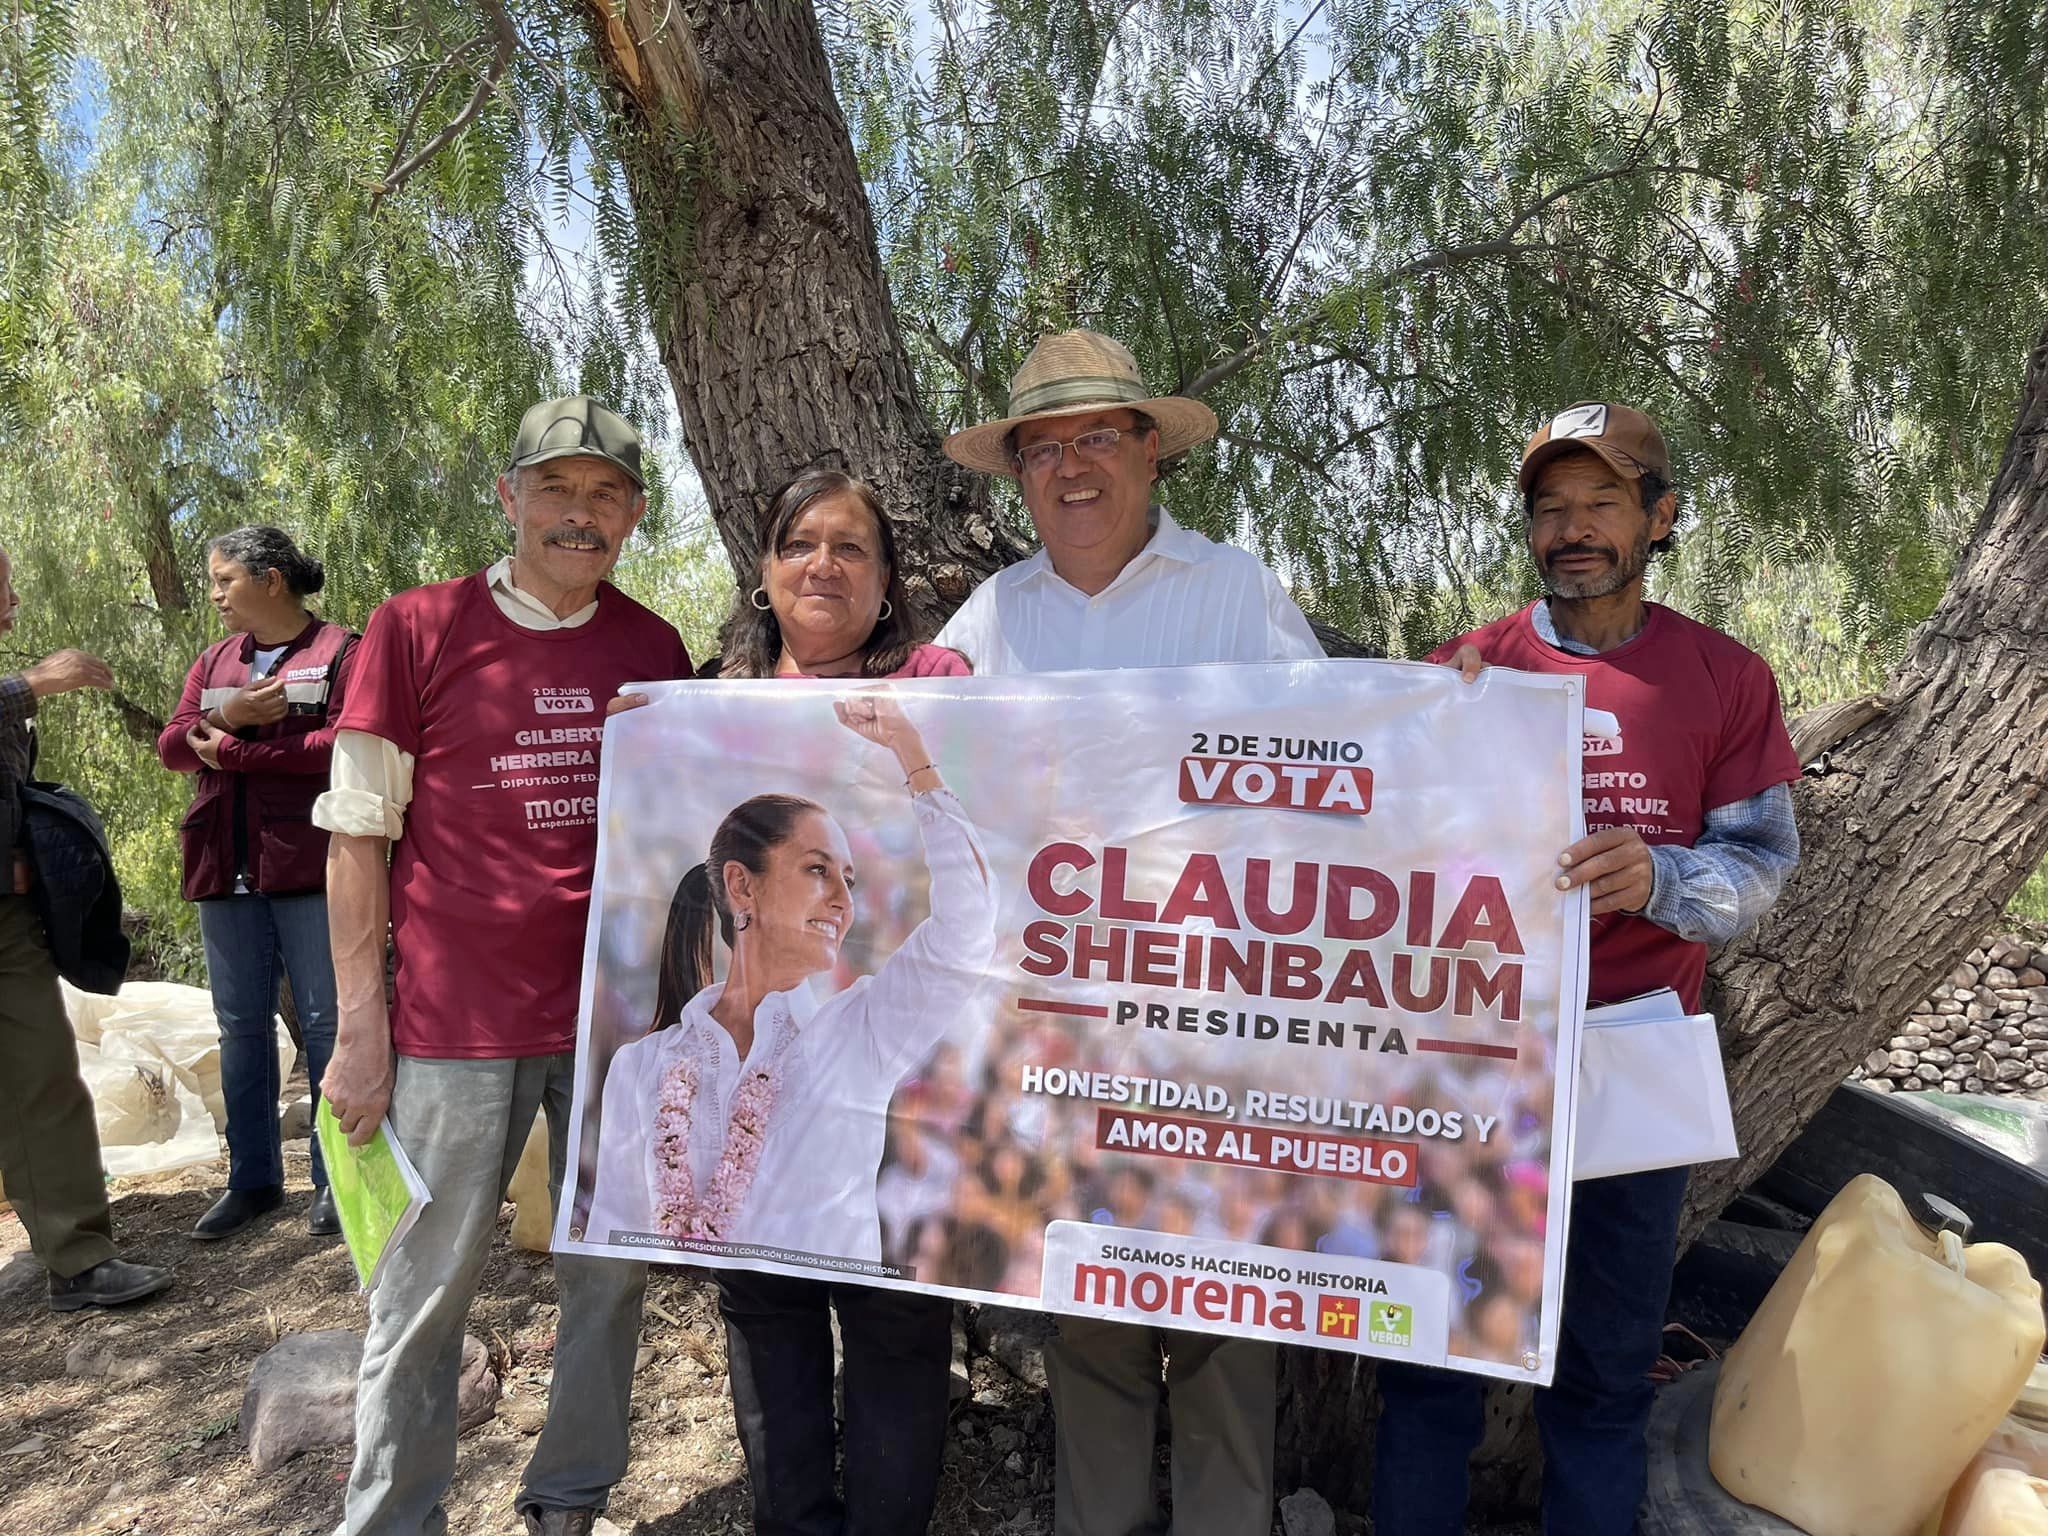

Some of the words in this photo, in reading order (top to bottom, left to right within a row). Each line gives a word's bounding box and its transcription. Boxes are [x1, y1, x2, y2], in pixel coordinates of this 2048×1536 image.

[533, 688, 540, 697] 2
[542, 688, 557, 696] DE
[559, 687, 590, 696] JUNIO
[544, 699, 586, 710] VOTA
[515, 727, 603, 746] GILBERT
[1191, 733, 1209, 754] 2
[1217, 734, 1259, 757] DE
[1267, 737, 1363, 763] JUNIO
[1583, 740, 1613, 751] OTA
[490, 750, 595, 772] HERRERA
[501, 775, 570, 789] DIPUTADO
[1185, 759, 1366, 810] VOTA
[1582, 772, 1647, 789] ERTO
[525, 796, 596, 820] more
[1620, 797, 1669, 816] RUIZ
[528, 822, 539, 830] La
[541, 818, 585, 830] esperanza
[1027, 841, 1526, 956] CLAUDIA
[1018, 920, 1525, 1022] SHEINBAUM
[1116, 1000, 1408, 1055] PRESIDENTA
[1021, 1064, 1236, 1120] HONESTIDAD,
[1246, 1089, 1463, 1140] RESULTADOS
[1473, 1113, 1497, 1143] Y
[1106, 1118, 1208, 1154] AMOR
[1215, 1131, 1261, 1163] AL
[1270, 1137, 1408, 1180] PUEBLO
[628, 1236, 675, 1248] CANDIDATA
[684, 1241, 733, 1254] PRESIDENTA
[783, 1253, 818, 1265] SIGAMOS
[820, 1258, 861, 1270] HACIENDO
[863, 1264, 901, 1276] HISTORIA
[1101, 1244, 1186, 1268] SIGAMOS
[1191, 1256, 1292, 1283] HACIENDO
[1297, 1269, 1389, 1296] HISTORIA
[1073, 1263, 1307, 1333] morena
[1322, 1311, 1356, 1336] PT
[1370, 1330, 1410, 1346] VERDE
